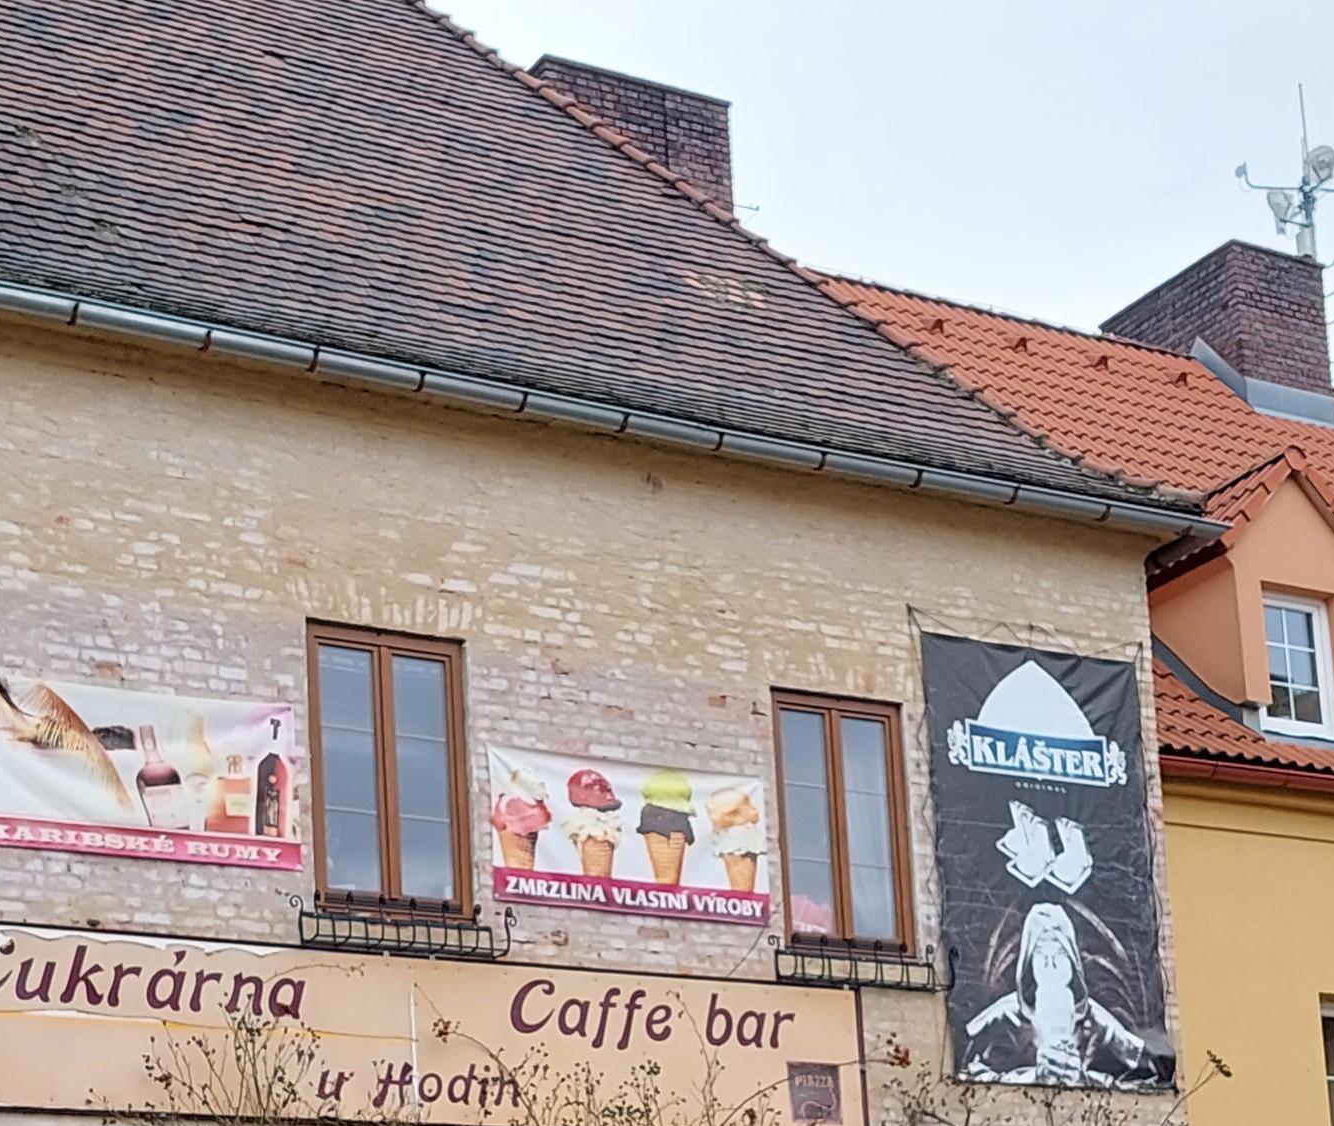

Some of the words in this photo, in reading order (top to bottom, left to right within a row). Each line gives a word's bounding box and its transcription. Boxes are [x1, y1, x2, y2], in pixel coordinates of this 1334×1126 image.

[971, 735, 1104, 778] KLÁŠTER
[186, 840, 283, 863] RUMY
[505, 876, 606, 902] ZMRZLINA
[611, 886, 689, 910] VLASTNÍ
[693, 893, 765, 918] VÝROBY
[706, 992, 795, 1049] bar
[317, 1069, 345, 1101] u
